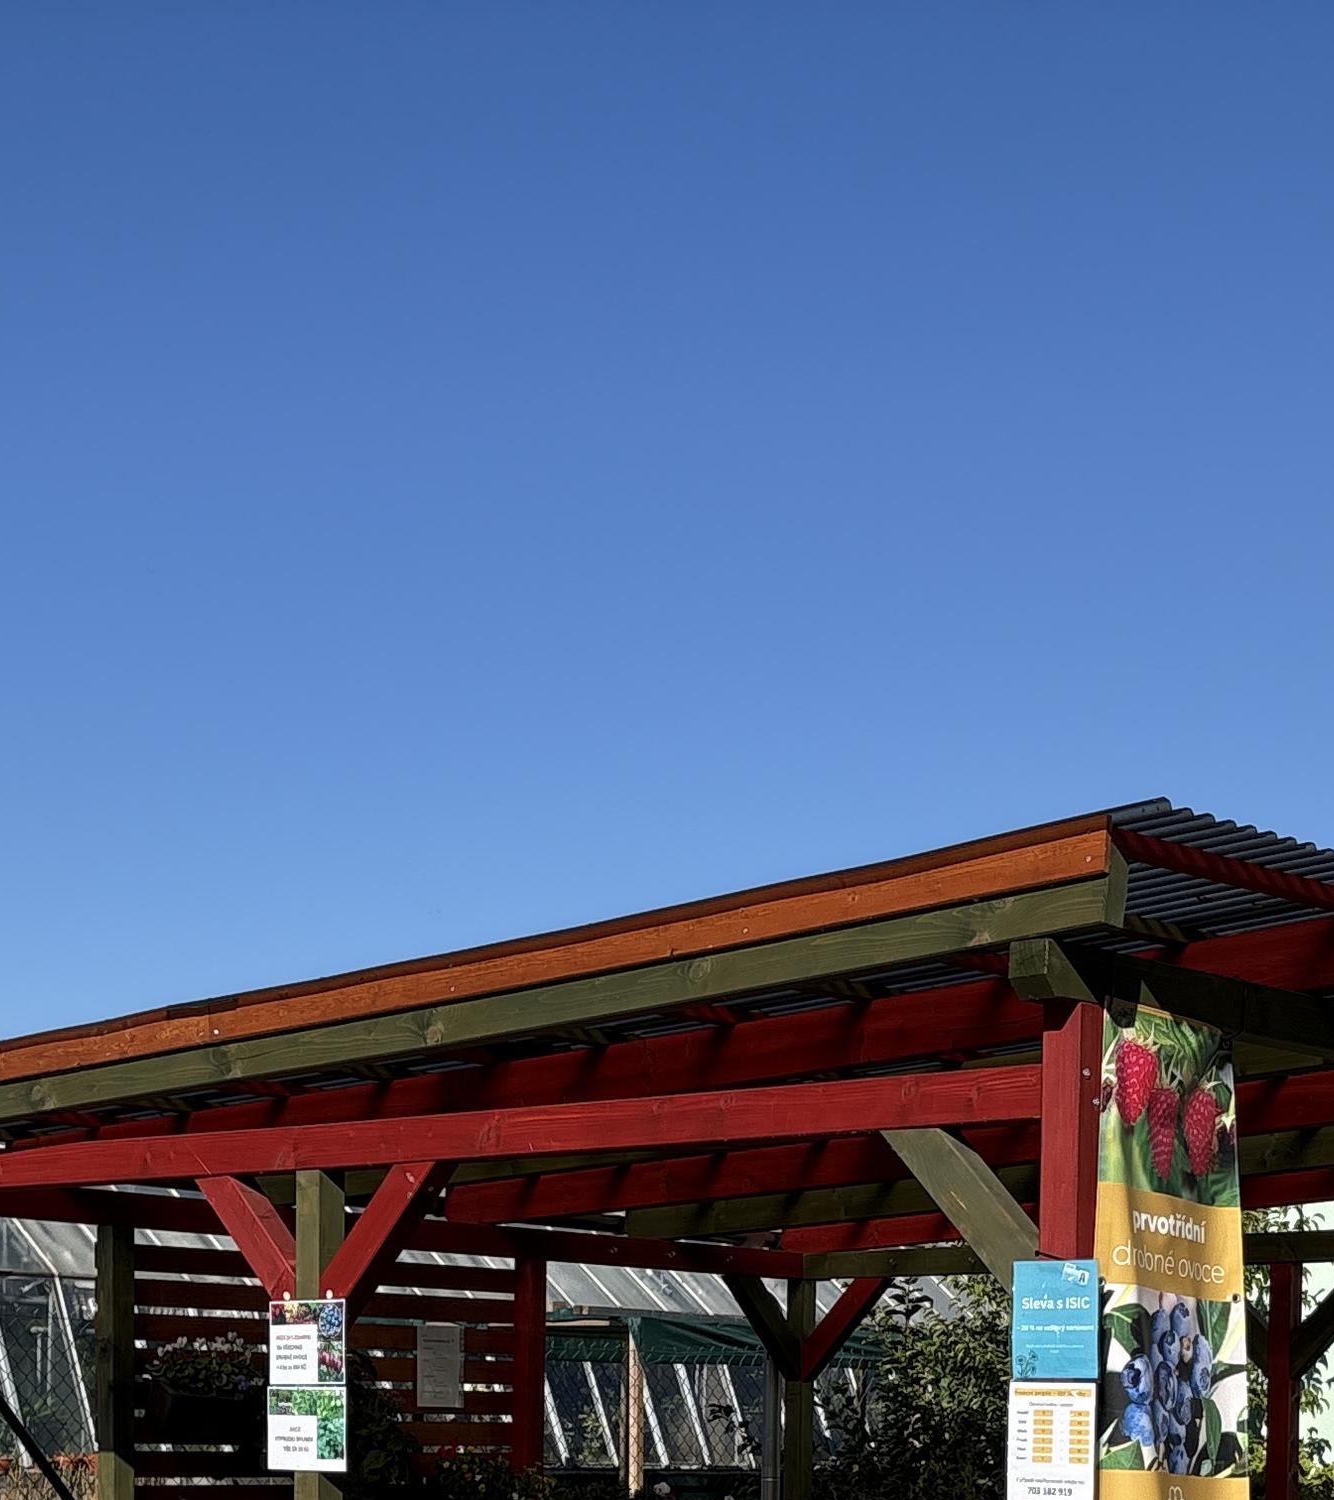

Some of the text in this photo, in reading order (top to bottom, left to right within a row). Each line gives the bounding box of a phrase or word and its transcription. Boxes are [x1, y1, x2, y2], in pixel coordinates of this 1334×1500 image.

[1132, 1210, 1206, 1244] prvotřídní
[1112, 1240, 1225, 1284] drobné ovoce
[1021, 1296, 1091, 1310] Sleva s ISIC
